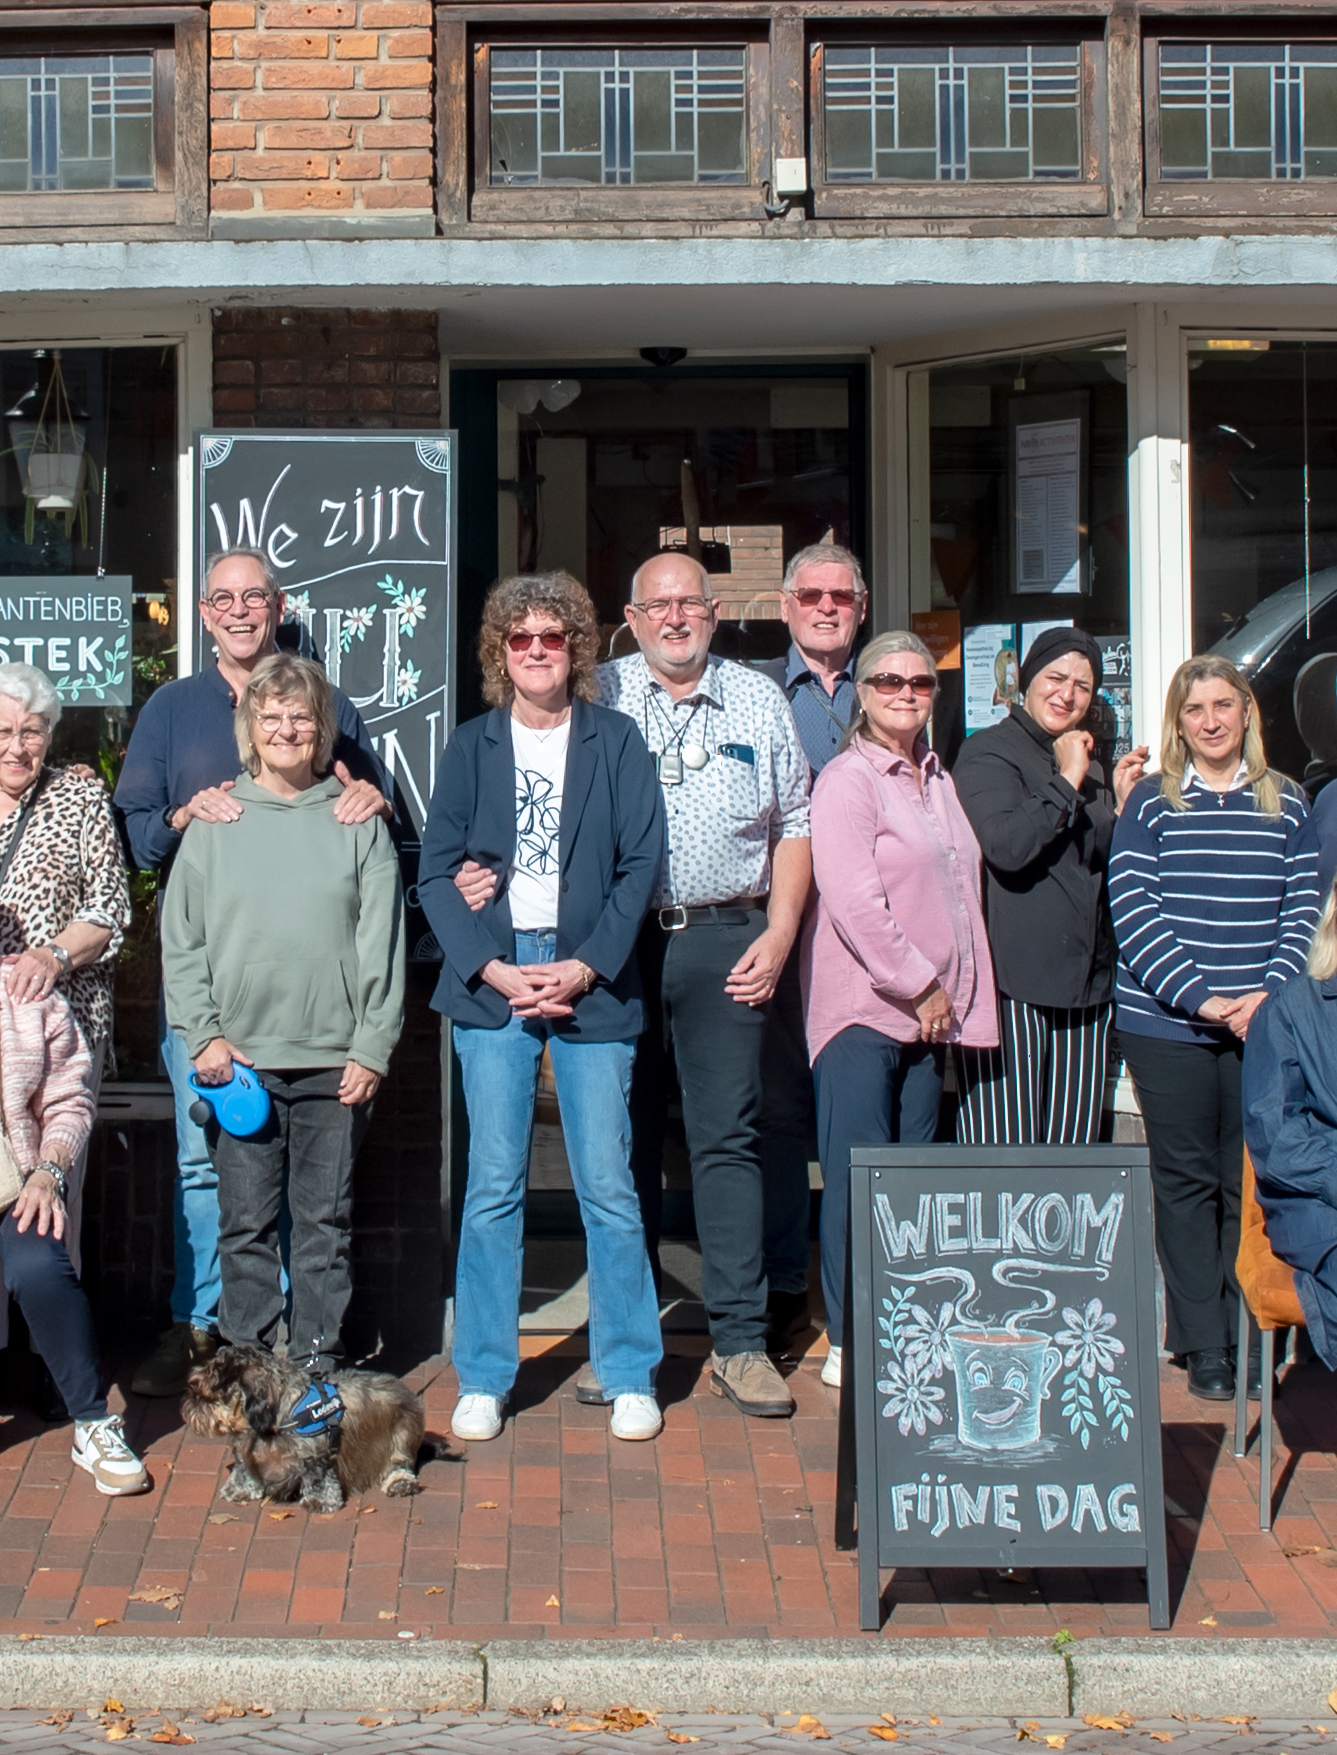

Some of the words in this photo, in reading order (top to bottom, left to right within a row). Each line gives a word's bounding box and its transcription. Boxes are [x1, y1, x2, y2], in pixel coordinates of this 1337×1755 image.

[210, 463, 299, 568] We
[320, 485, 430, 555] zijn
[873, 1191, 1125, 1263] WELKOM
[1036, 1483, 1142, 1534] DAG
